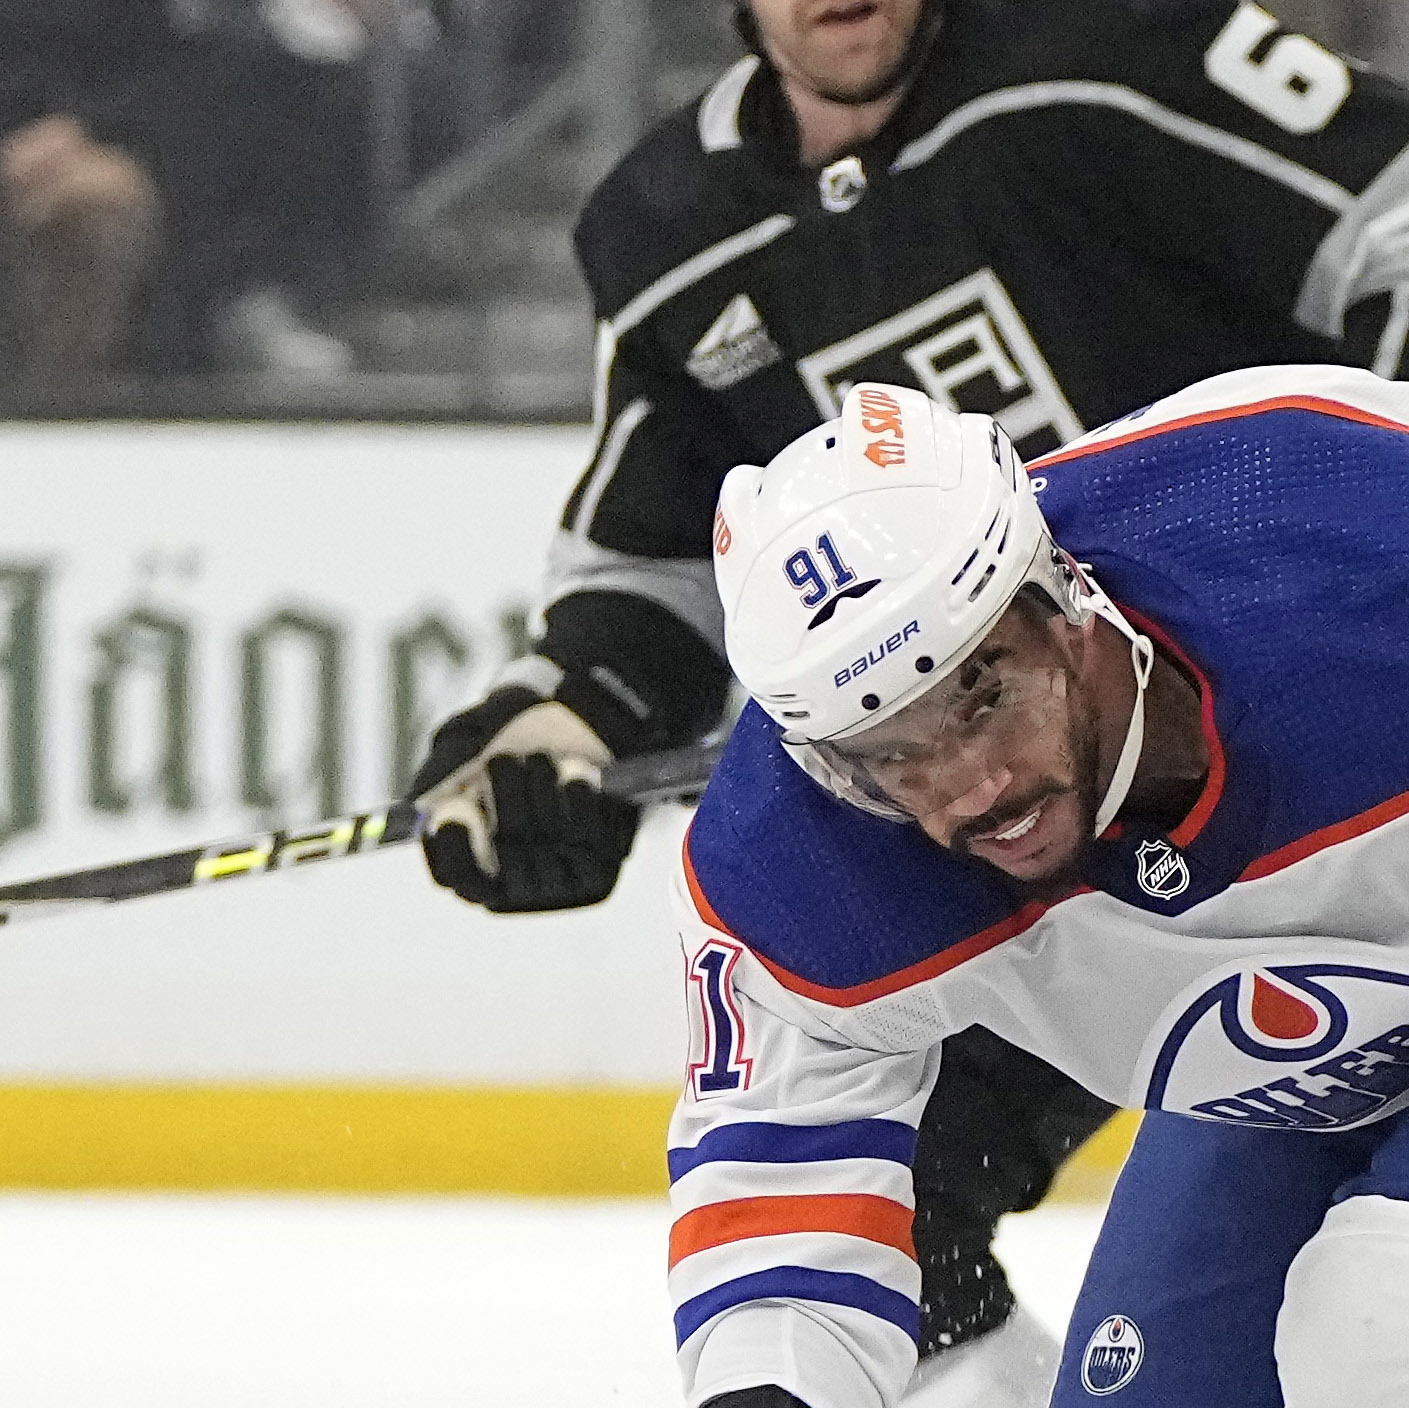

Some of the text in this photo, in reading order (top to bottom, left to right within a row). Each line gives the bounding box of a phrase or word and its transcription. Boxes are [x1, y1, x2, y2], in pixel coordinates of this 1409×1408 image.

[1203, 1, 1351, 134] 6
[782, 529, 858, 609] 91
[834, 619, 921, 689] BAUER
[1150, 855, 1177, 887] NHL
